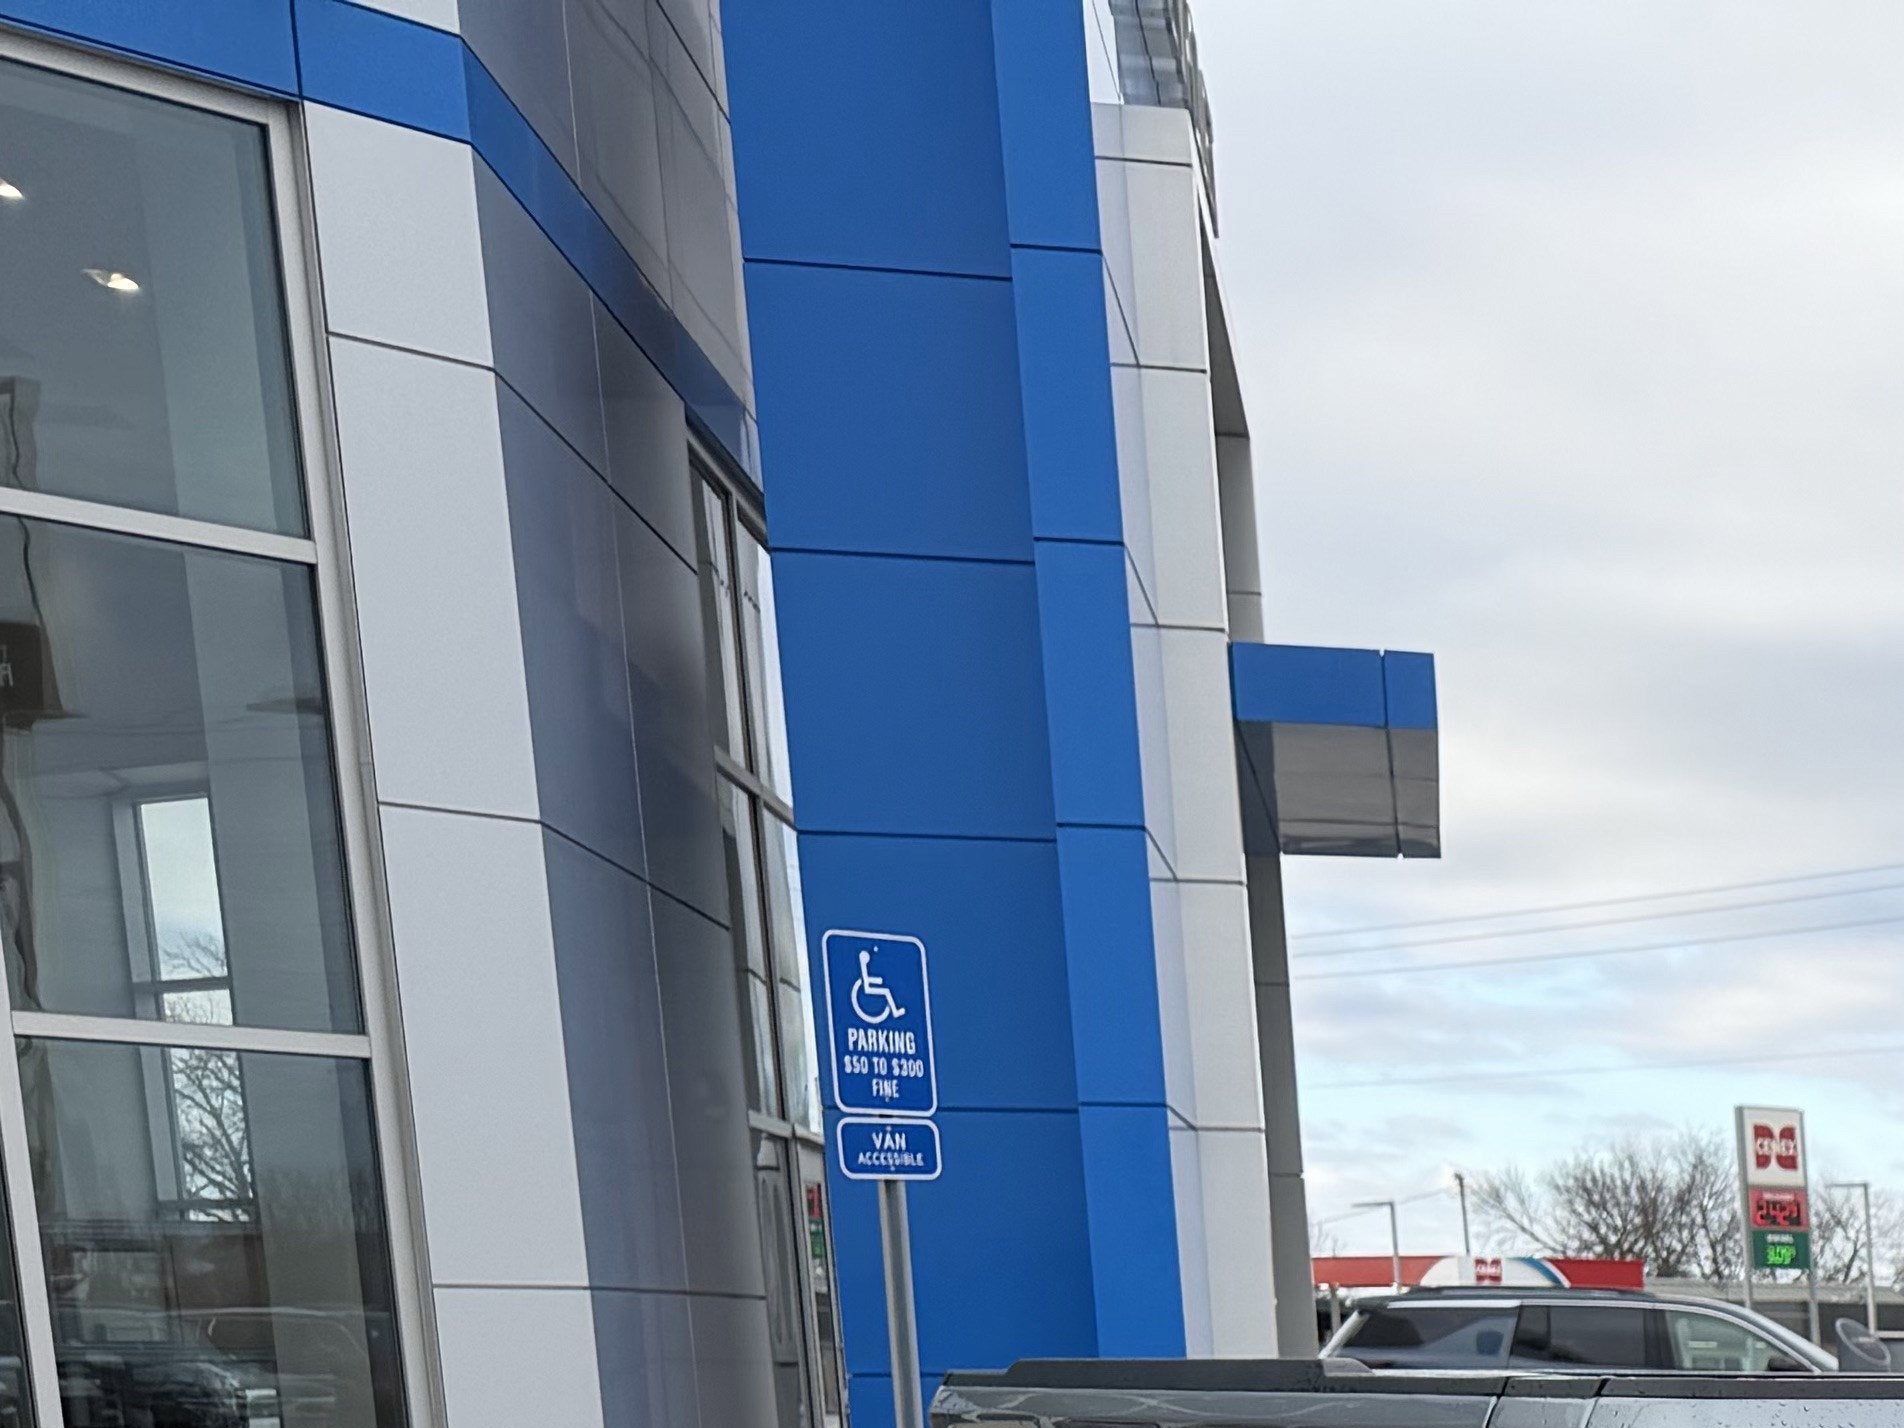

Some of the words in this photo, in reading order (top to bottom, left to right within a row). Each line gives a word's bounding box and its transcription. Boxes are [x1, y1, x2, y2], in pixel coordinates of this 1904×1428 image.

[847, 1028, 916, 1055] PARKING
[844, 1055, 868, 1074] $50
[872, 1056, 887, 1075] TO
[891, 1057, 924, 1077] $300
[871, 1078, 899, 1098] FINE
[872, 1132, 906, 1150] VAN
[858, 1151, 924, 1167] ACCESSIBLE
